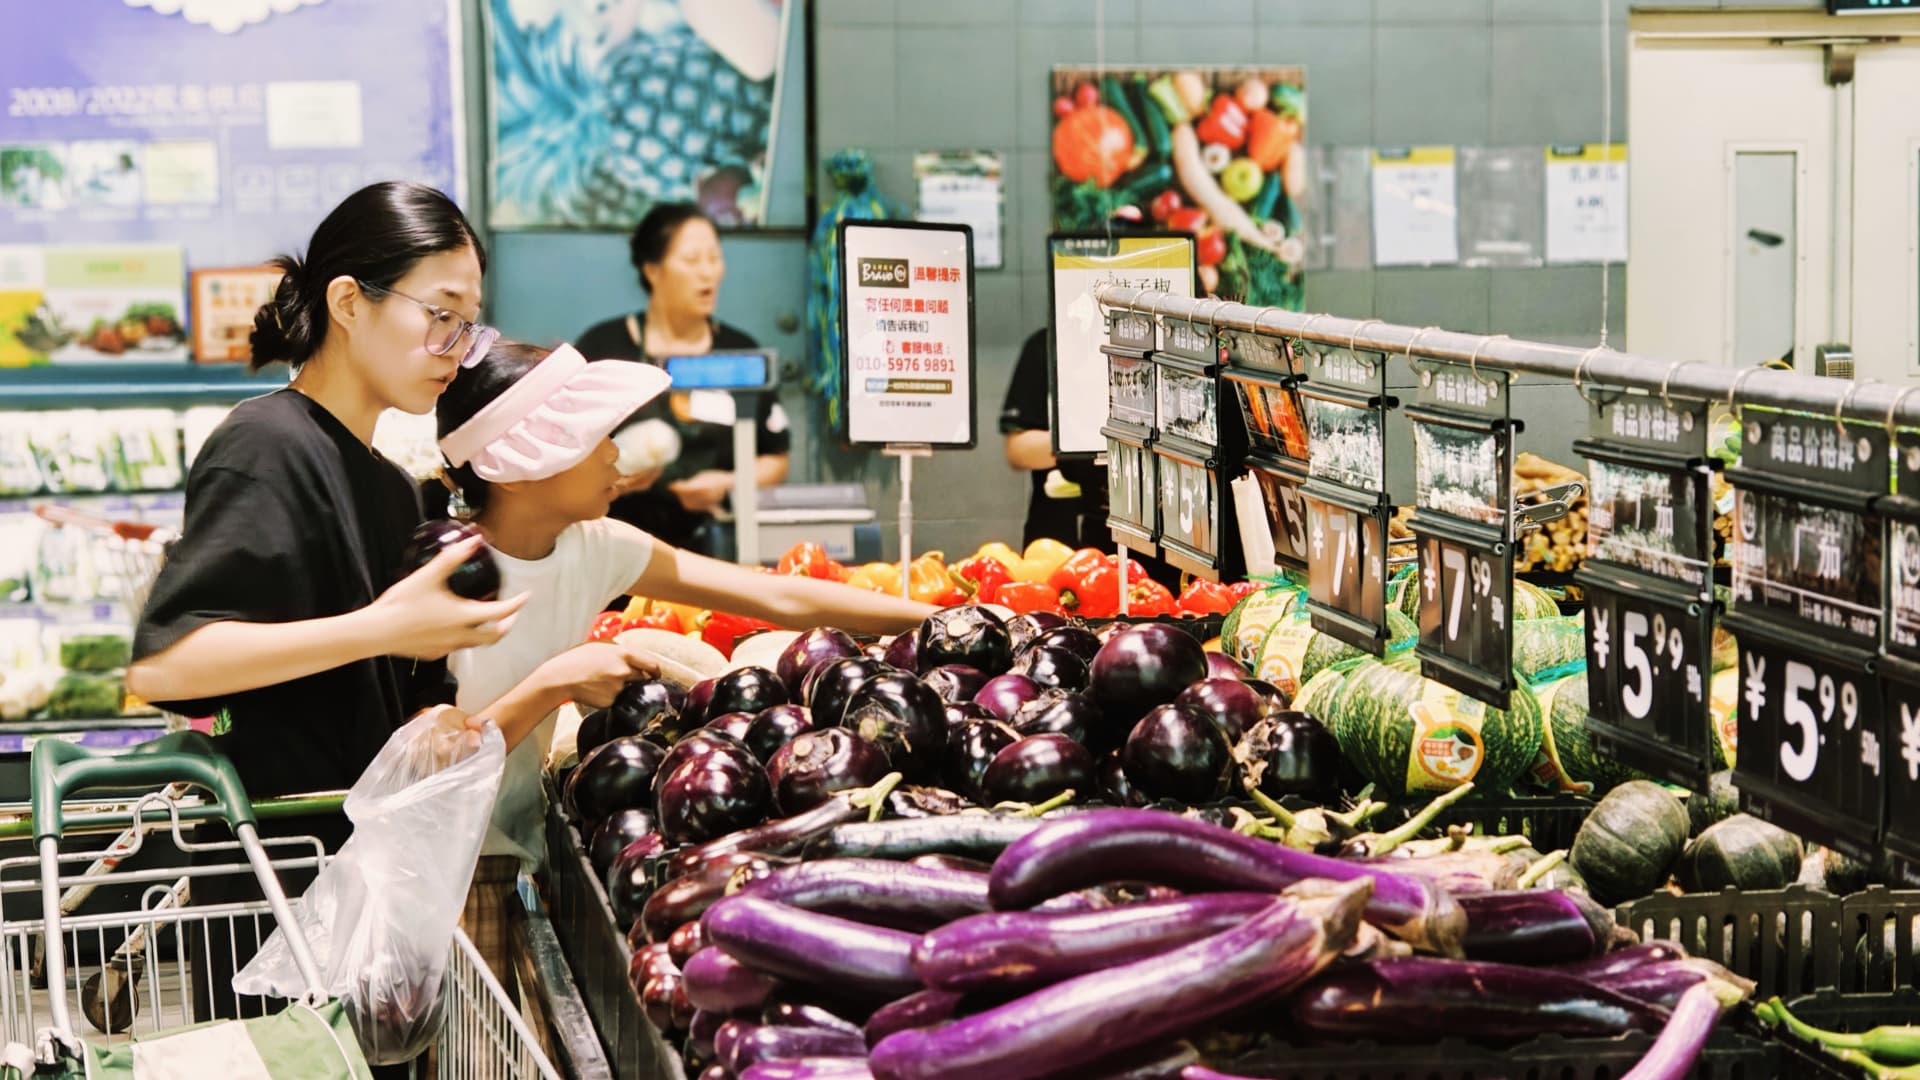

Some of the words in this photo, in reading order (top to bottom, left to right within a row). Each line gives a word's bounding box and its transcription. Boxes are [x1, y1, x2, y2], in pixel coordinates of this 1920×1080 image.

[914, 266, 960, 282] 温馨提示
[865, 297, 948, 314] 有任何质量问题
[924, 358, 955, 372] 9891
